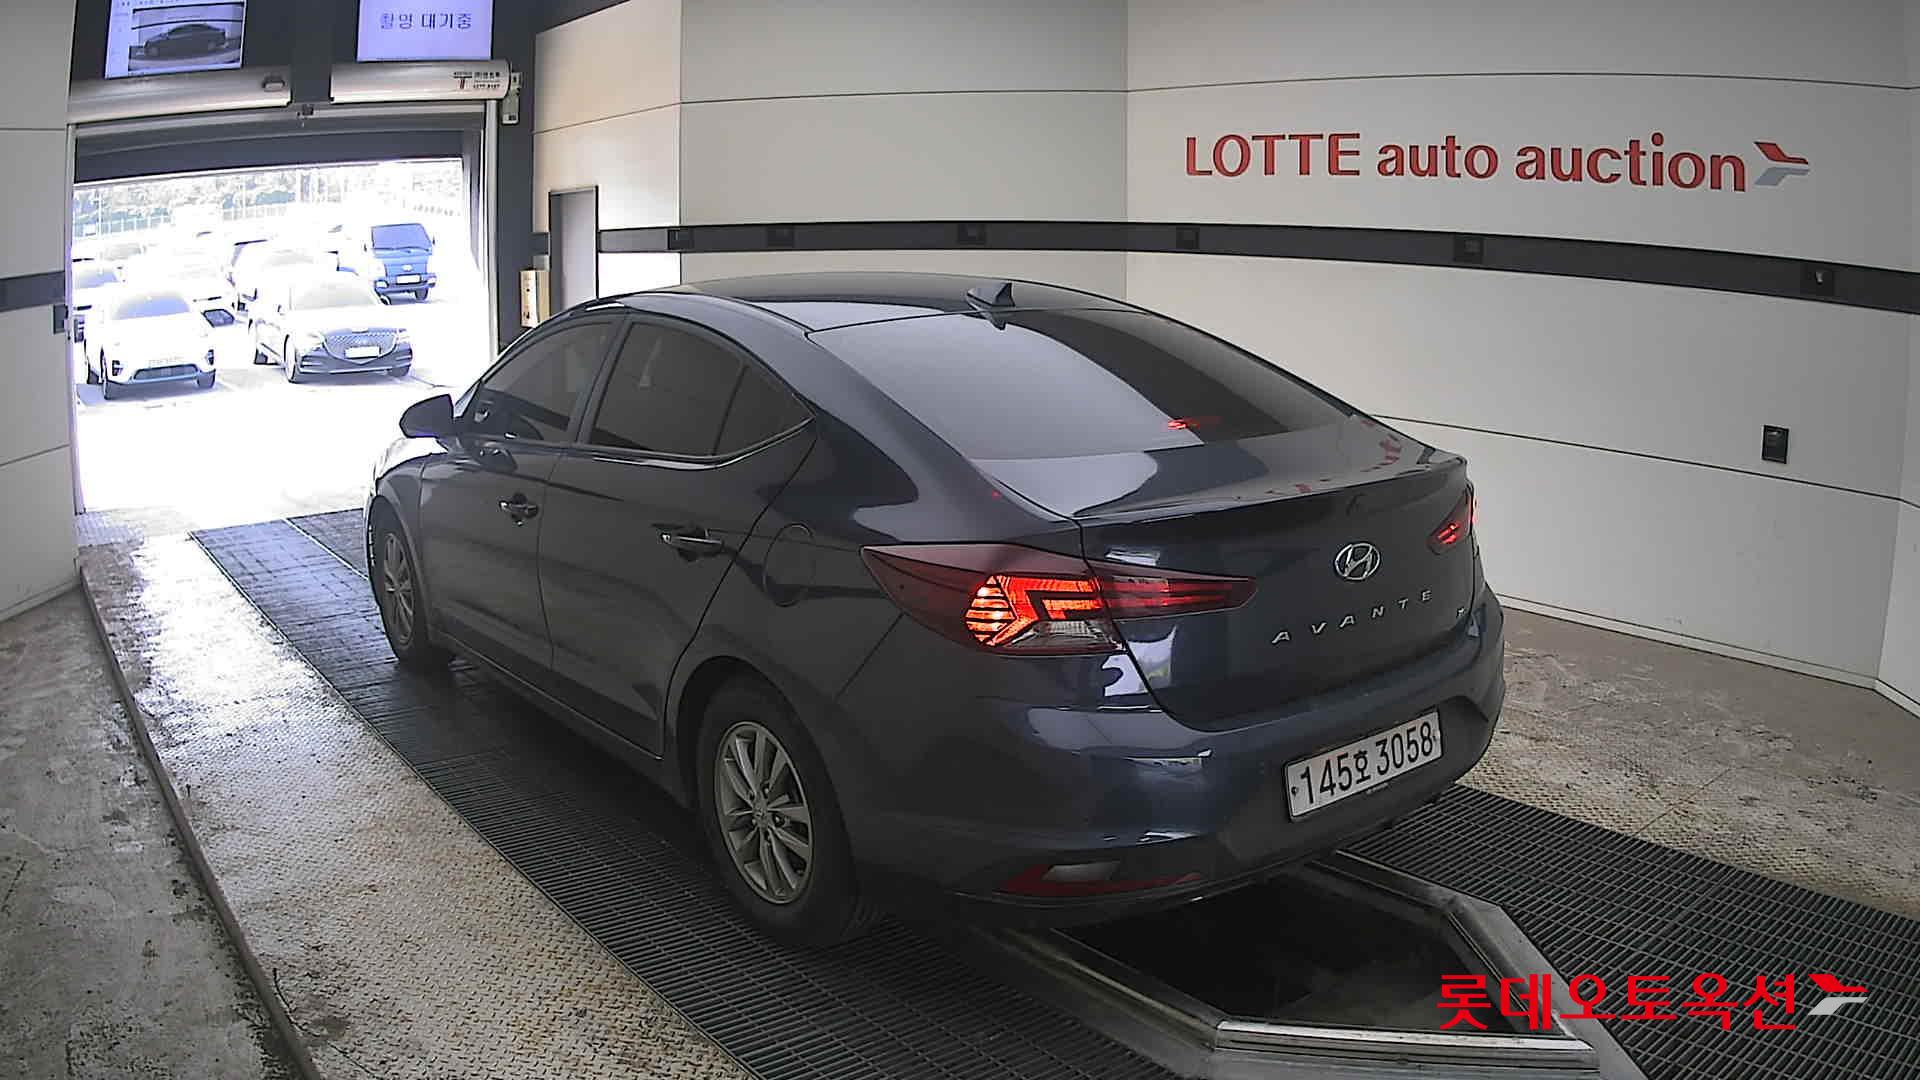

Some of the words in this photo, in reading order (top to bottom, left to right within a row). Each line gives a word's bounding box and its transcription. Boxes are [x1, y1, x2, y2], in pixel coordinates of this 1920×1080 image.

[421, 12, 472, 30] 대기중
[1186, 132, 1360, 177] LOTTE
[1377, 135, 1498, 179] auto
[1515, 132, 1746, 192] auction
[1272, 590, 1432, 643] AVANTE
[1300, 750, 1371, 805] 145호
[1375, 721, 1433, 776] 3058
